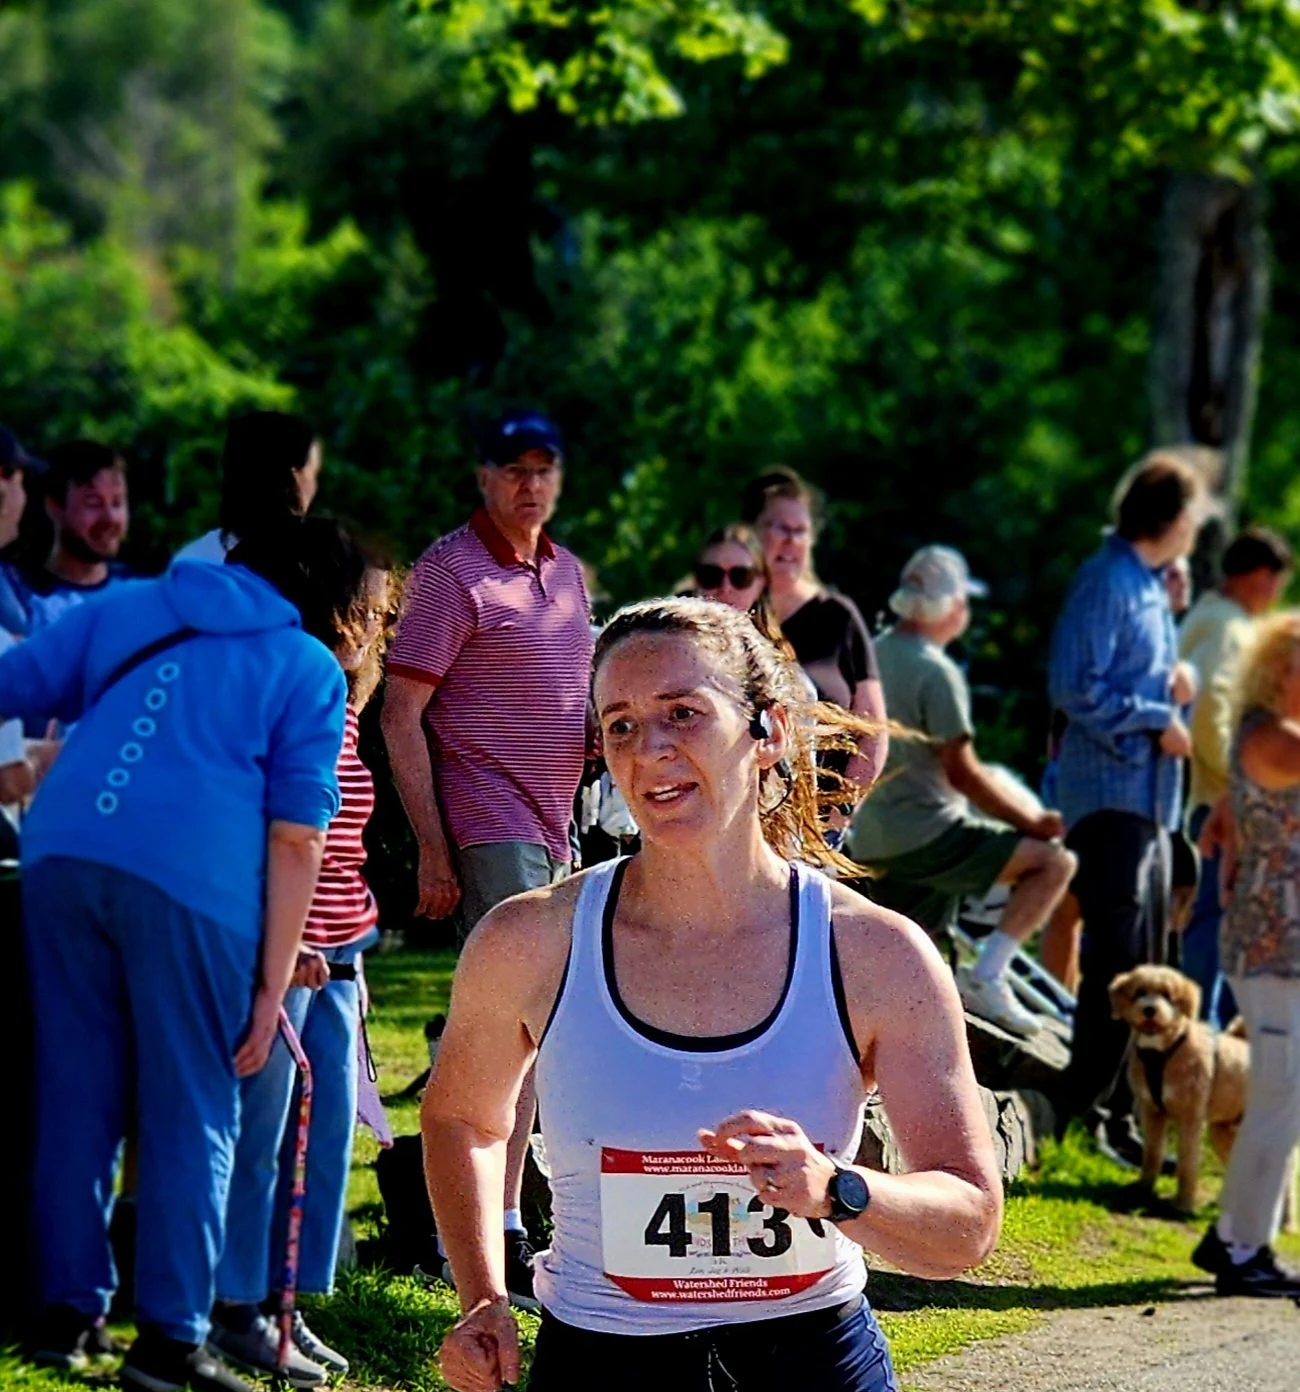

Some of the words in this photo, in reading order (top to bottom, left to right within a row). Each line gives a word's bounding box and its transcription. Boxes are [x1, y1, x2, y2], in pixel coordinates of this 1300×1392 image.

[641, 1153, 705, 1164] Maranacook
[706, 1154, 730, 1164] La
[644, 1192, 792, 1258] 413
[673, 1279, 727, 1289] Watershed
[729, 1279, 768, 1289] Friends
[651, 1287, 791, 1299] www.watershedfriends.com
